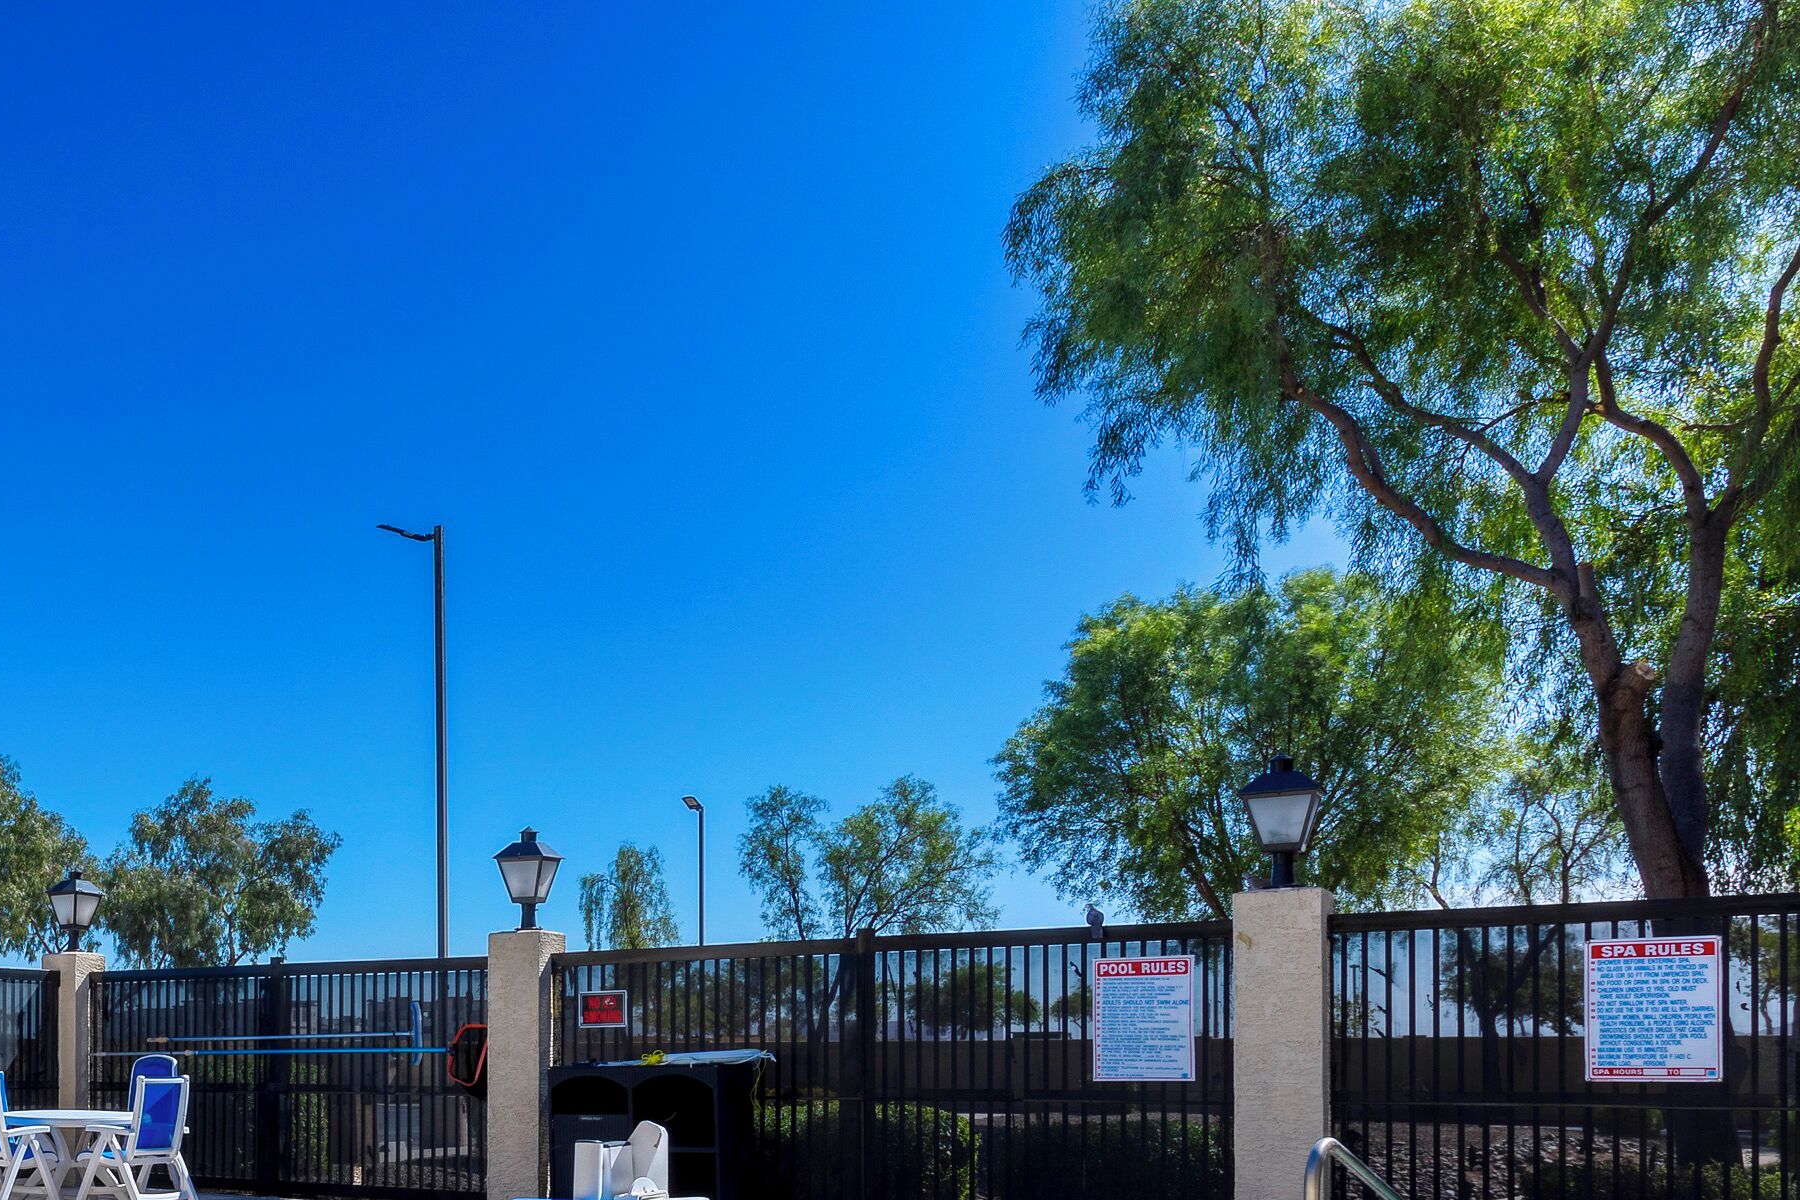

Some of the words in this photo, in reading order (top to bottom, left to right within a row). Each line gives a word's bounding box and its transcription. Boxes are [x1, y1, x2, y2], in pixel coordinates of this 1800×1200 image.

[1601, 946, 1637, 957] SPA
[1645, 943, 1704, 956] RULES
[1100, 964, 1136, 974] POOL
[1142, 962, 1185, 974] RULES
